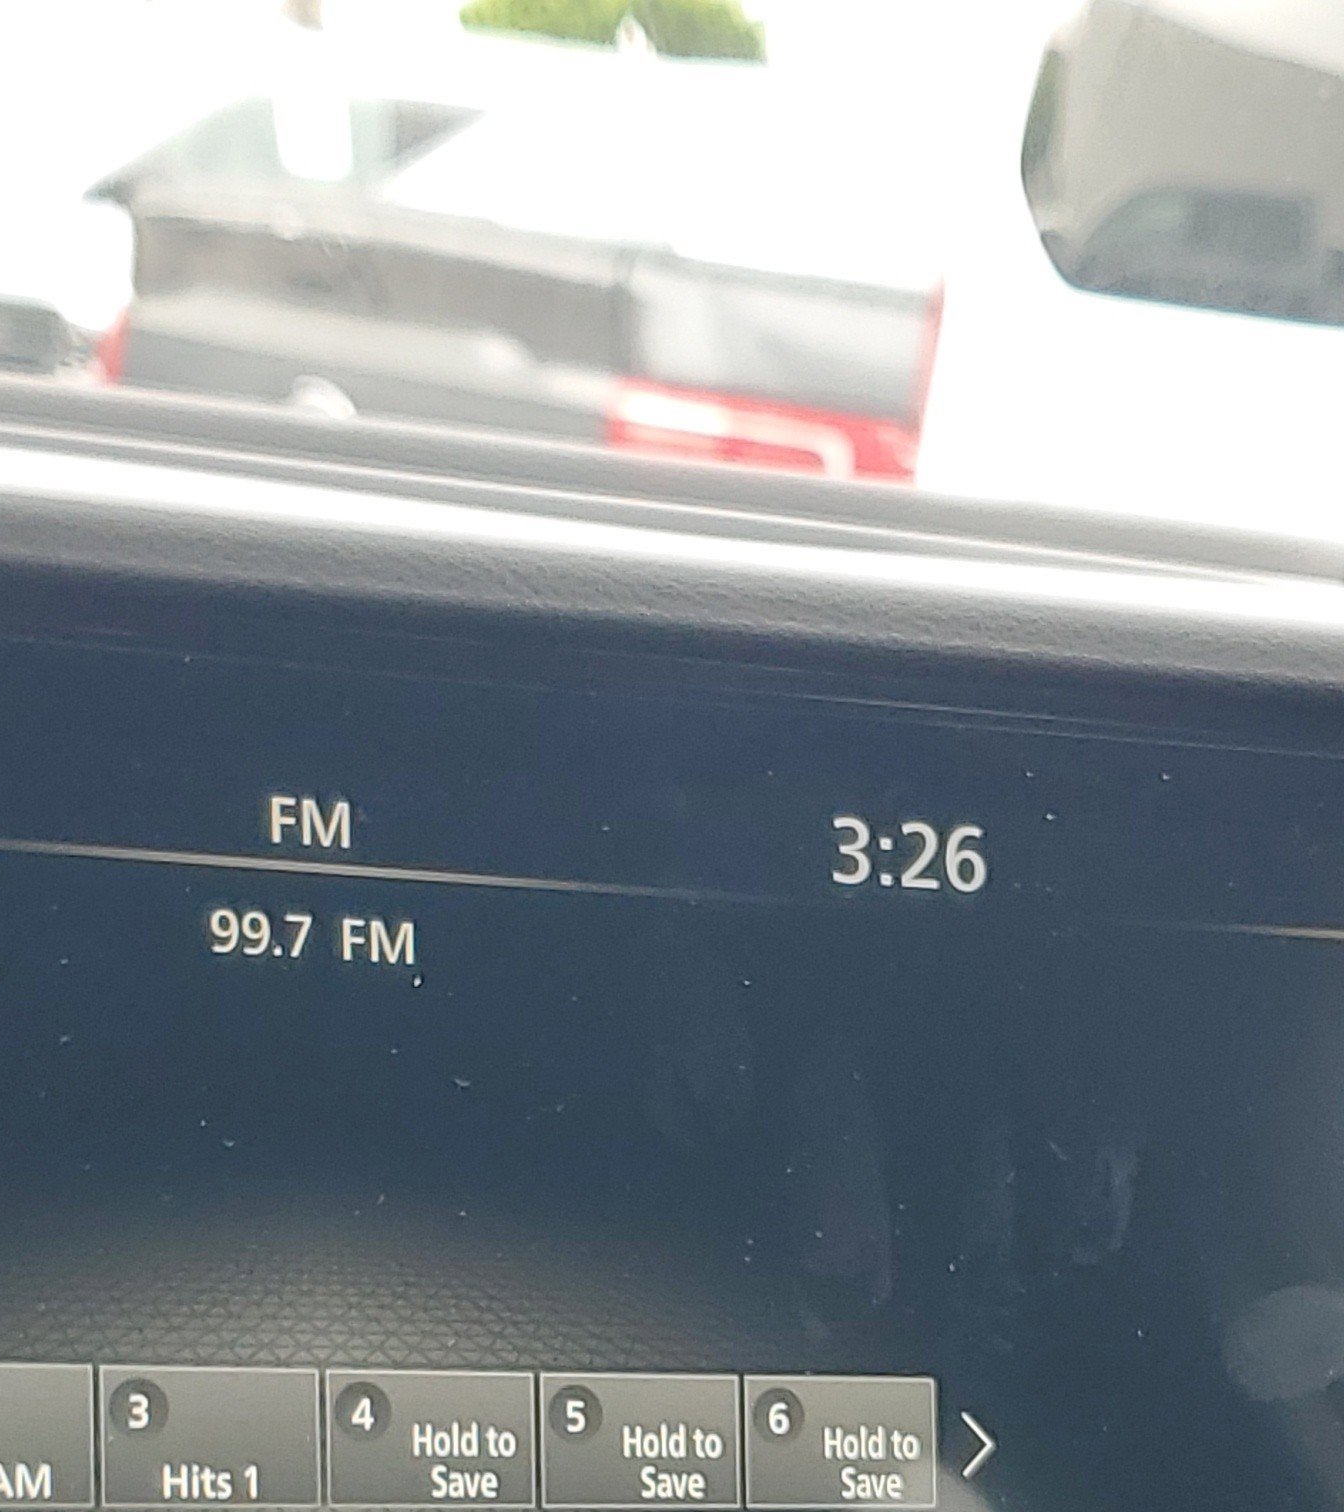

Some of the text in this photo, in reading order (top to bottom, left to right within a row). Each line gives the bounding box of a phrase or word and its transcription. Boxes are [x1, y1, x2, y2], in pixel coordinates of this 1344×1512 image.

[268, 796, 352, 849] FM
[831, 815, 987, 894] 3:26
[209, 908, 418, 966] 99.7 FM
[126, 1394, 151, 1429] 3
[351, 1398, 375, 1431] 4
[564, 1399, 586, 1433] 5
[768, 1402, 791, 1436] 6
[412, 1422, 518, 1459] Hold to
[622, 1424, 723, 1460] Hold to
[823, 1426, 921, 1462] Hold to
[161, 1462, 260, 1498] Hits 1
[430, 1465, 499, 1499] Save
[640, 1467, 706, 1499] Save
[840, 1467, 903, 1500] Save
